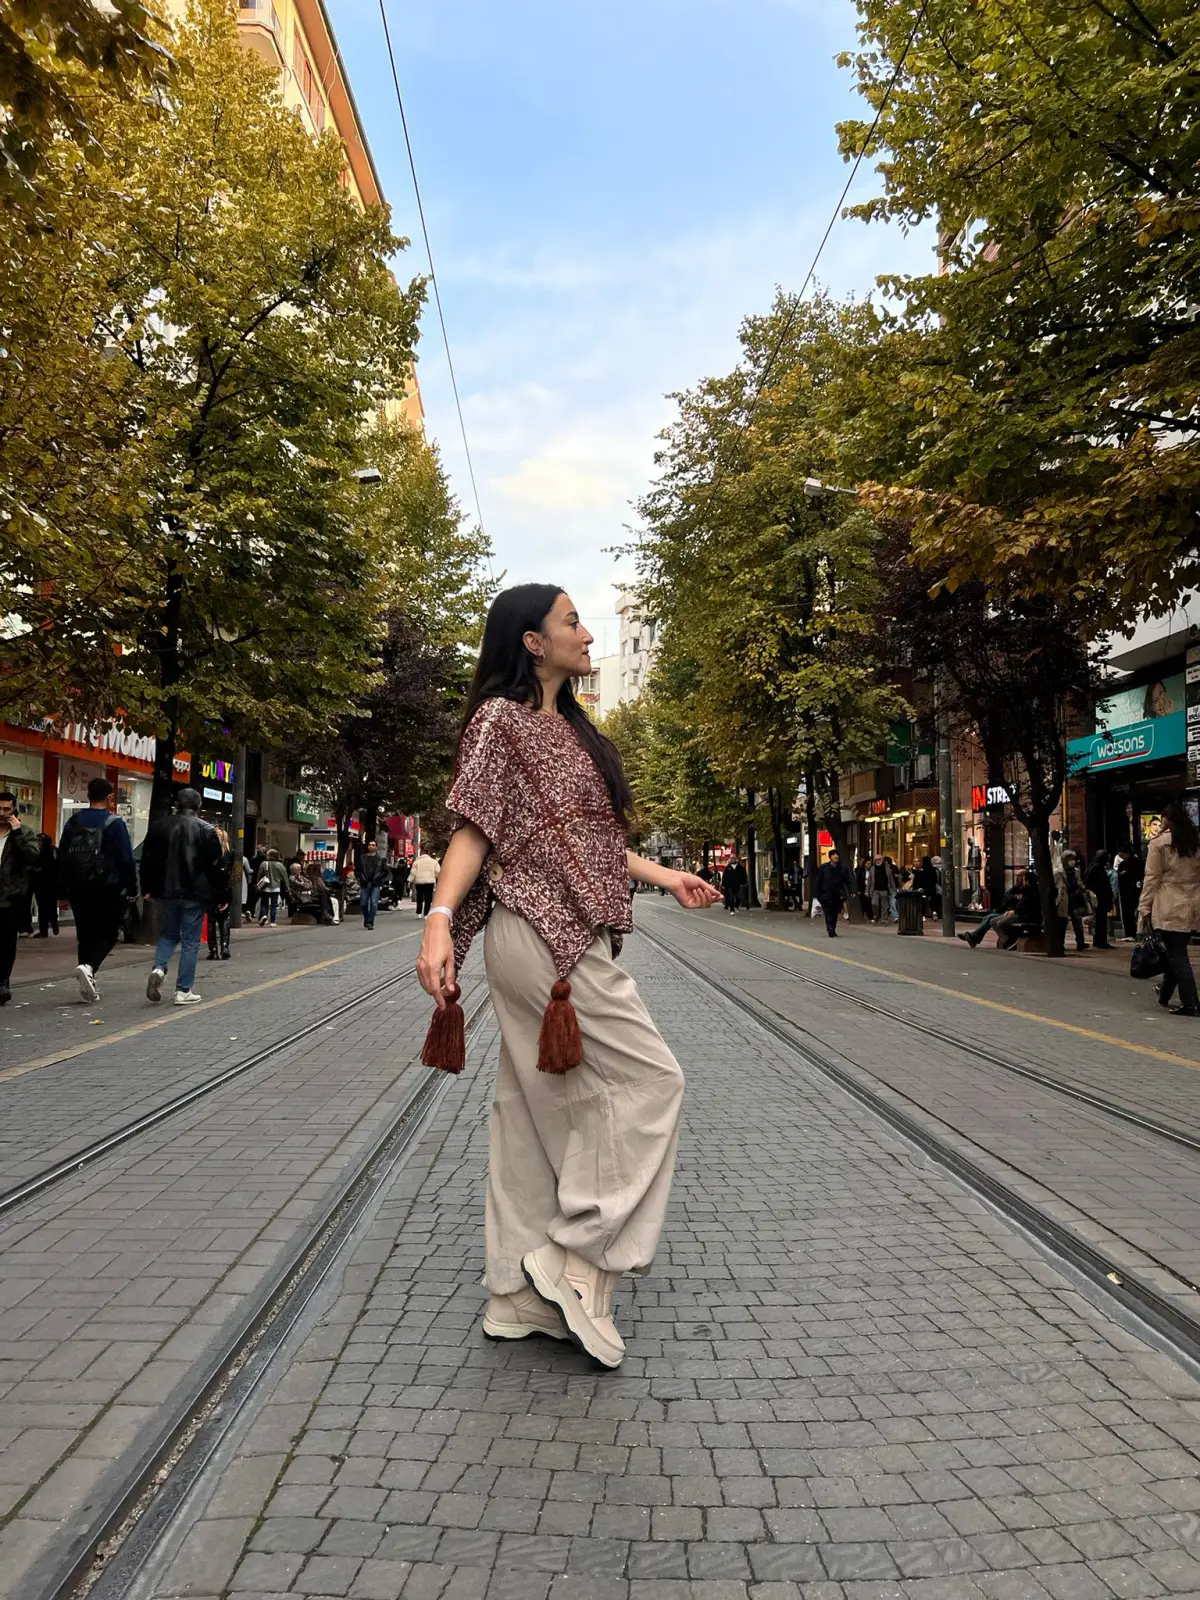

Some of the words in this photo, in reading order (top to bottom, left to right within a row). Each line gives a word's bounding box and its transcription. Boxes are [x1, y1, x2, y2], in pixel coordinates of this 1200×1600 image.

[1096, 734, 1145, 758] watsons
[172, 758, 190, 772] oppo
[972, 784, 986, 812] IN
[987, 782, 1017, 805] STRET
